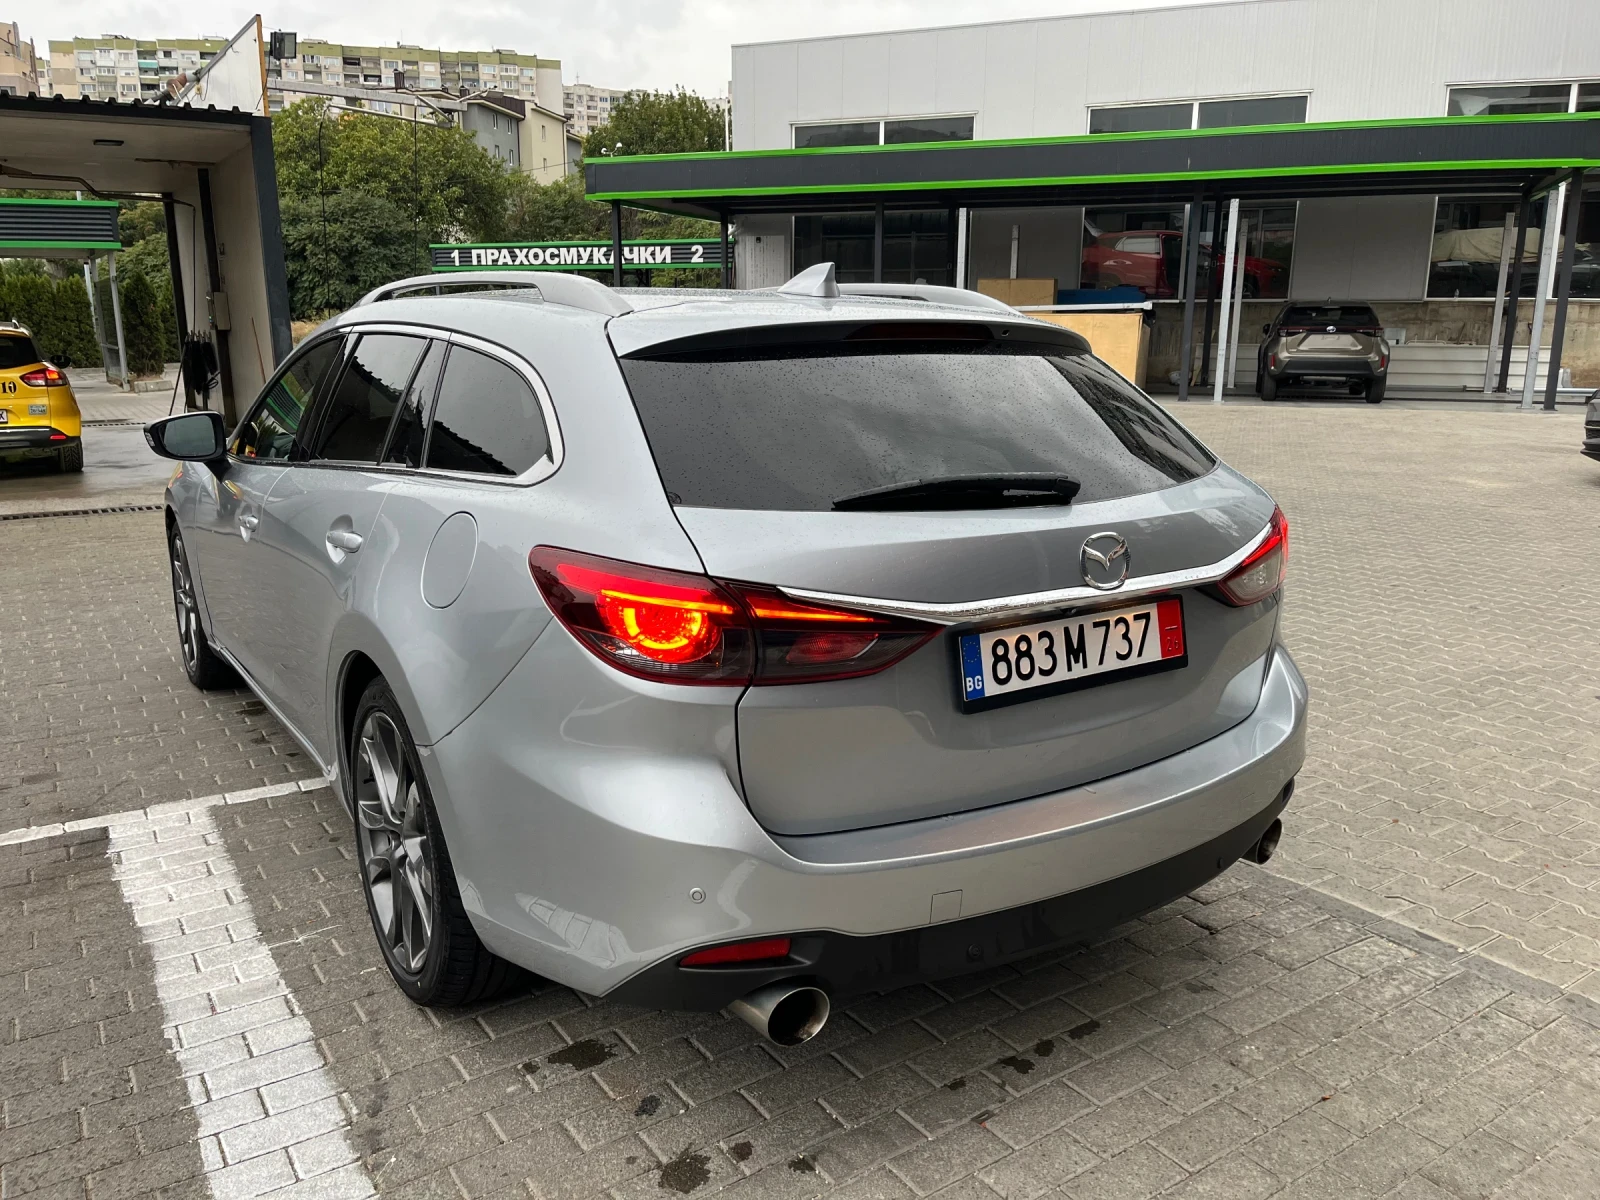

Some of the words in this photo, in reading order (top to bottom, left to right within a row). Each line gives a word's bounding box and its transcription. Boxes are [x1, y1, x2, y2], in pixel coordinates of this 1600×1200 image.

[451, 249, 460, 266] 1
[690, 244, 704, 264] 2
[965, 675, 983, 692] BG
[991, 630, 1058, 686] 883
[1092, 611, 1151, 666] 737
